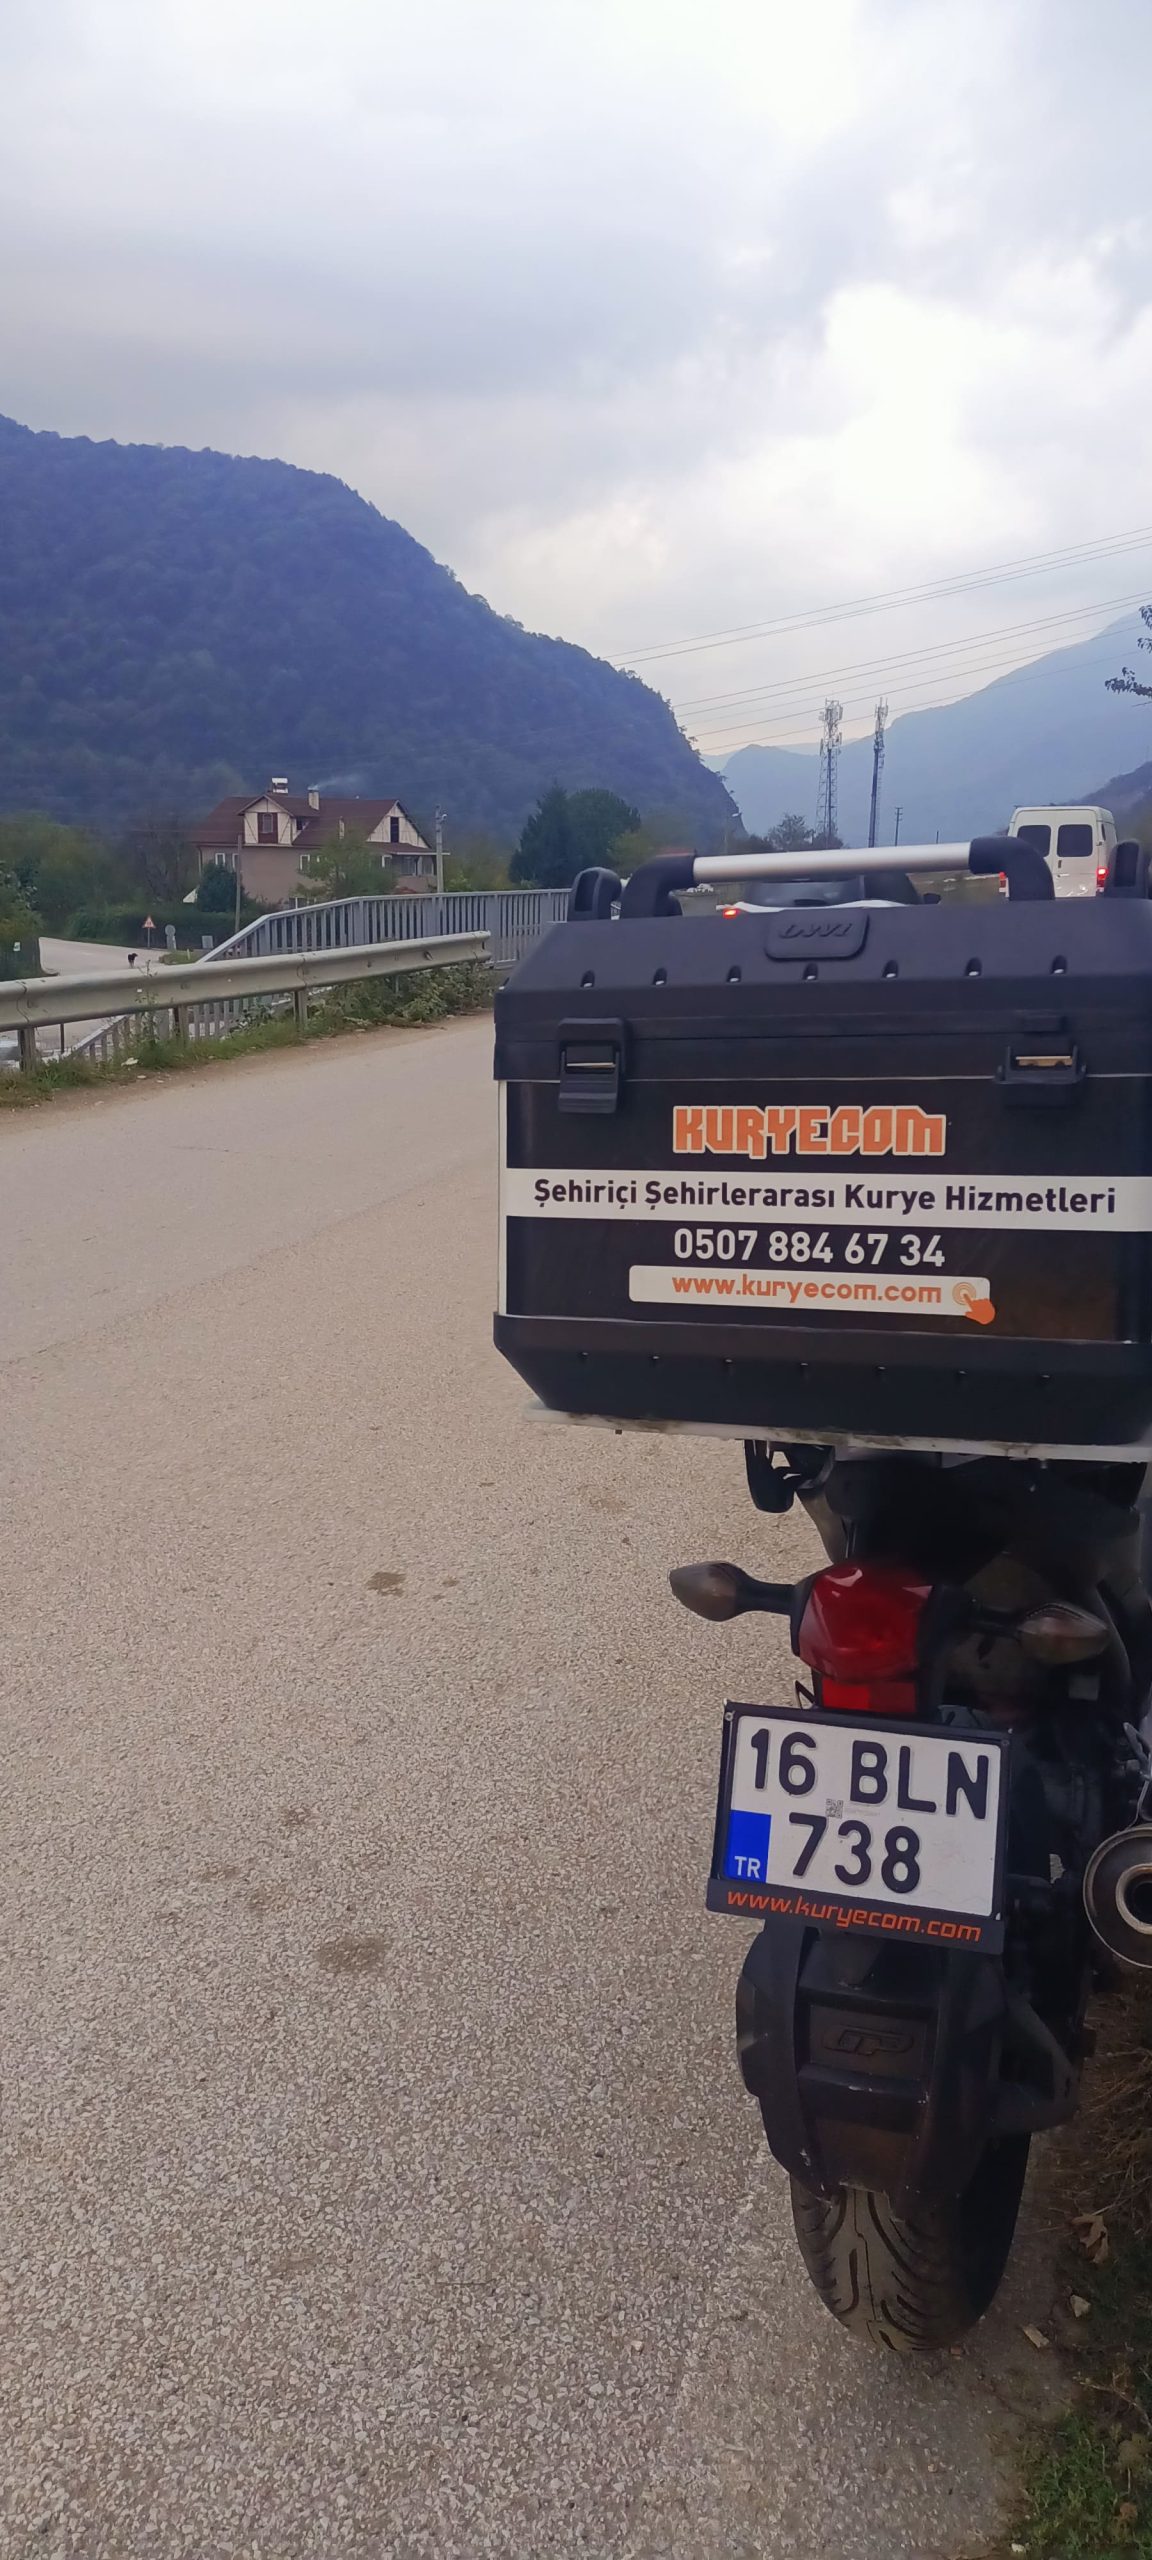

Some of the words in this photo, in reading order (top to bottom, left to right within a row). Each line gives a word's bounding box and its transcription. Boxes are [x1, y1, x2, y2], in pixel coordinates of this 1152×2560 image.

[673, 1106, 946, 1159] KURYECOM
[534, 1178, 637, 1208] Şehiriçi
[645, 1181, 834, 1210] Şehirlerarası
[845, 1184, 935, 1215] Kurye
[945, 1186, 1115, 1213] Hizmetleri
[674, 1228, 758, 1260] 0507
[768, 1231, 833, 1263] 884
[844, 1233, 889, 1265] 67
[899, 1234, 945, 1267] 34
[672, 1274, 942, 1304] www.kuryecom.com
[751, 1728, 817, 1796] 16
[850, 1740, 989, 1820] BLN
[734, 1856, 761, 1878] TR
[789, 1811, 921, 1894] 738
[727, 1890, 982, 1942] www.kuryecom.com
